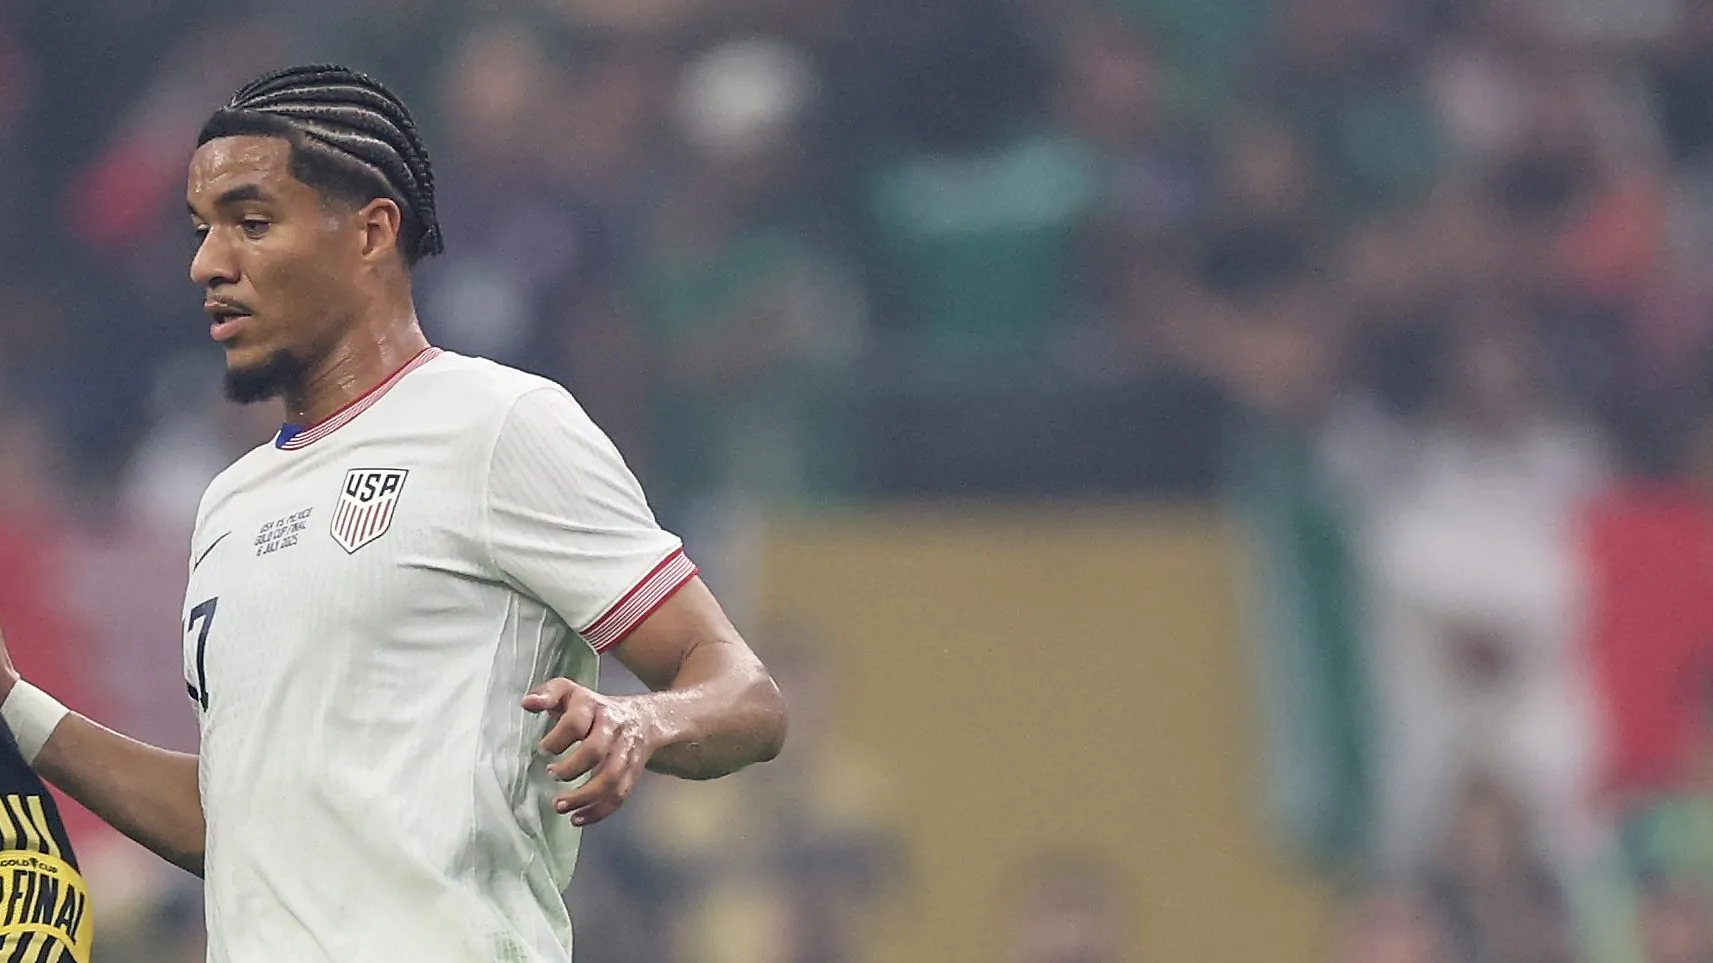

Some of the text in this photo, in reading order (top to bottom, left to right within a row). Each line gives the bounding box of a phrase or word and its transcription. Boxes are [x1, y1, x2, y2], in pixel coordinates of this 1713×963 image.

[345, 473, 401, 502] USA
[186, 596, 219, 713] 7
[0, 859, 30, 868] GOLD
